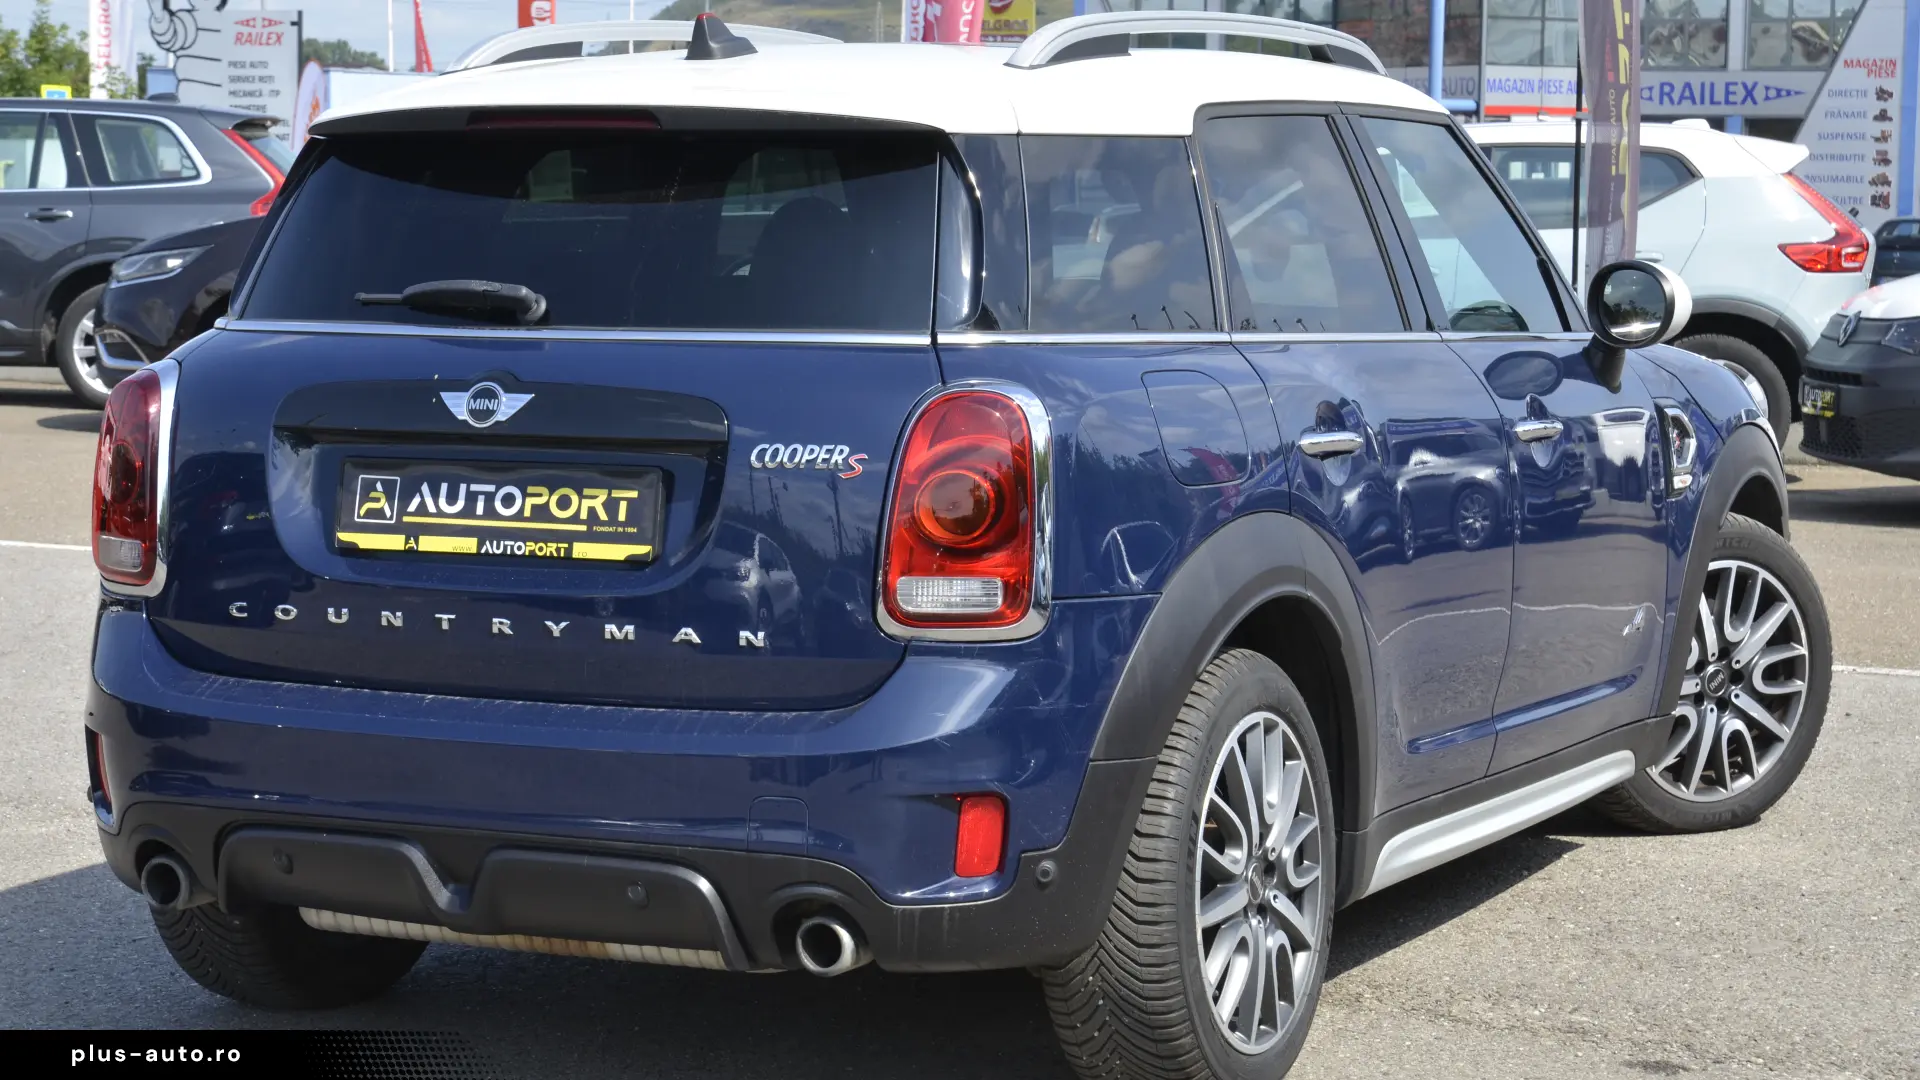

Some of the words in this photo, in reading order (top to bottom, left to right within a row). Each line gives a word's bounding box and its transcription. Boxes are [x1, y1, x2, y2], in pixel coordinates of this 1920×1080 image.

[234, 31, 284, 46] RAILEX
[1843, 59, 1897, 69] MAGAZIN
[1867, 68, 1897, 79] PIESE
[1486, 78, 1535, 94] MAGAZIN
[1538, 79, 1564, 95] PIESE
[1658, 81, 1759, 106] RAILEX
[1817, 131, 1867, 141] SUSPENSIE
[468, 398, 499, 411] MINI
[750, 443, 850, 469] COOPER
[837, 453, 869, 479] S
[406, 481, 639, 522] AUTOPORT
[480, 540, 569, 557] AUTOPORT
[228, 602, 766, 648] COUNTRYMAN
